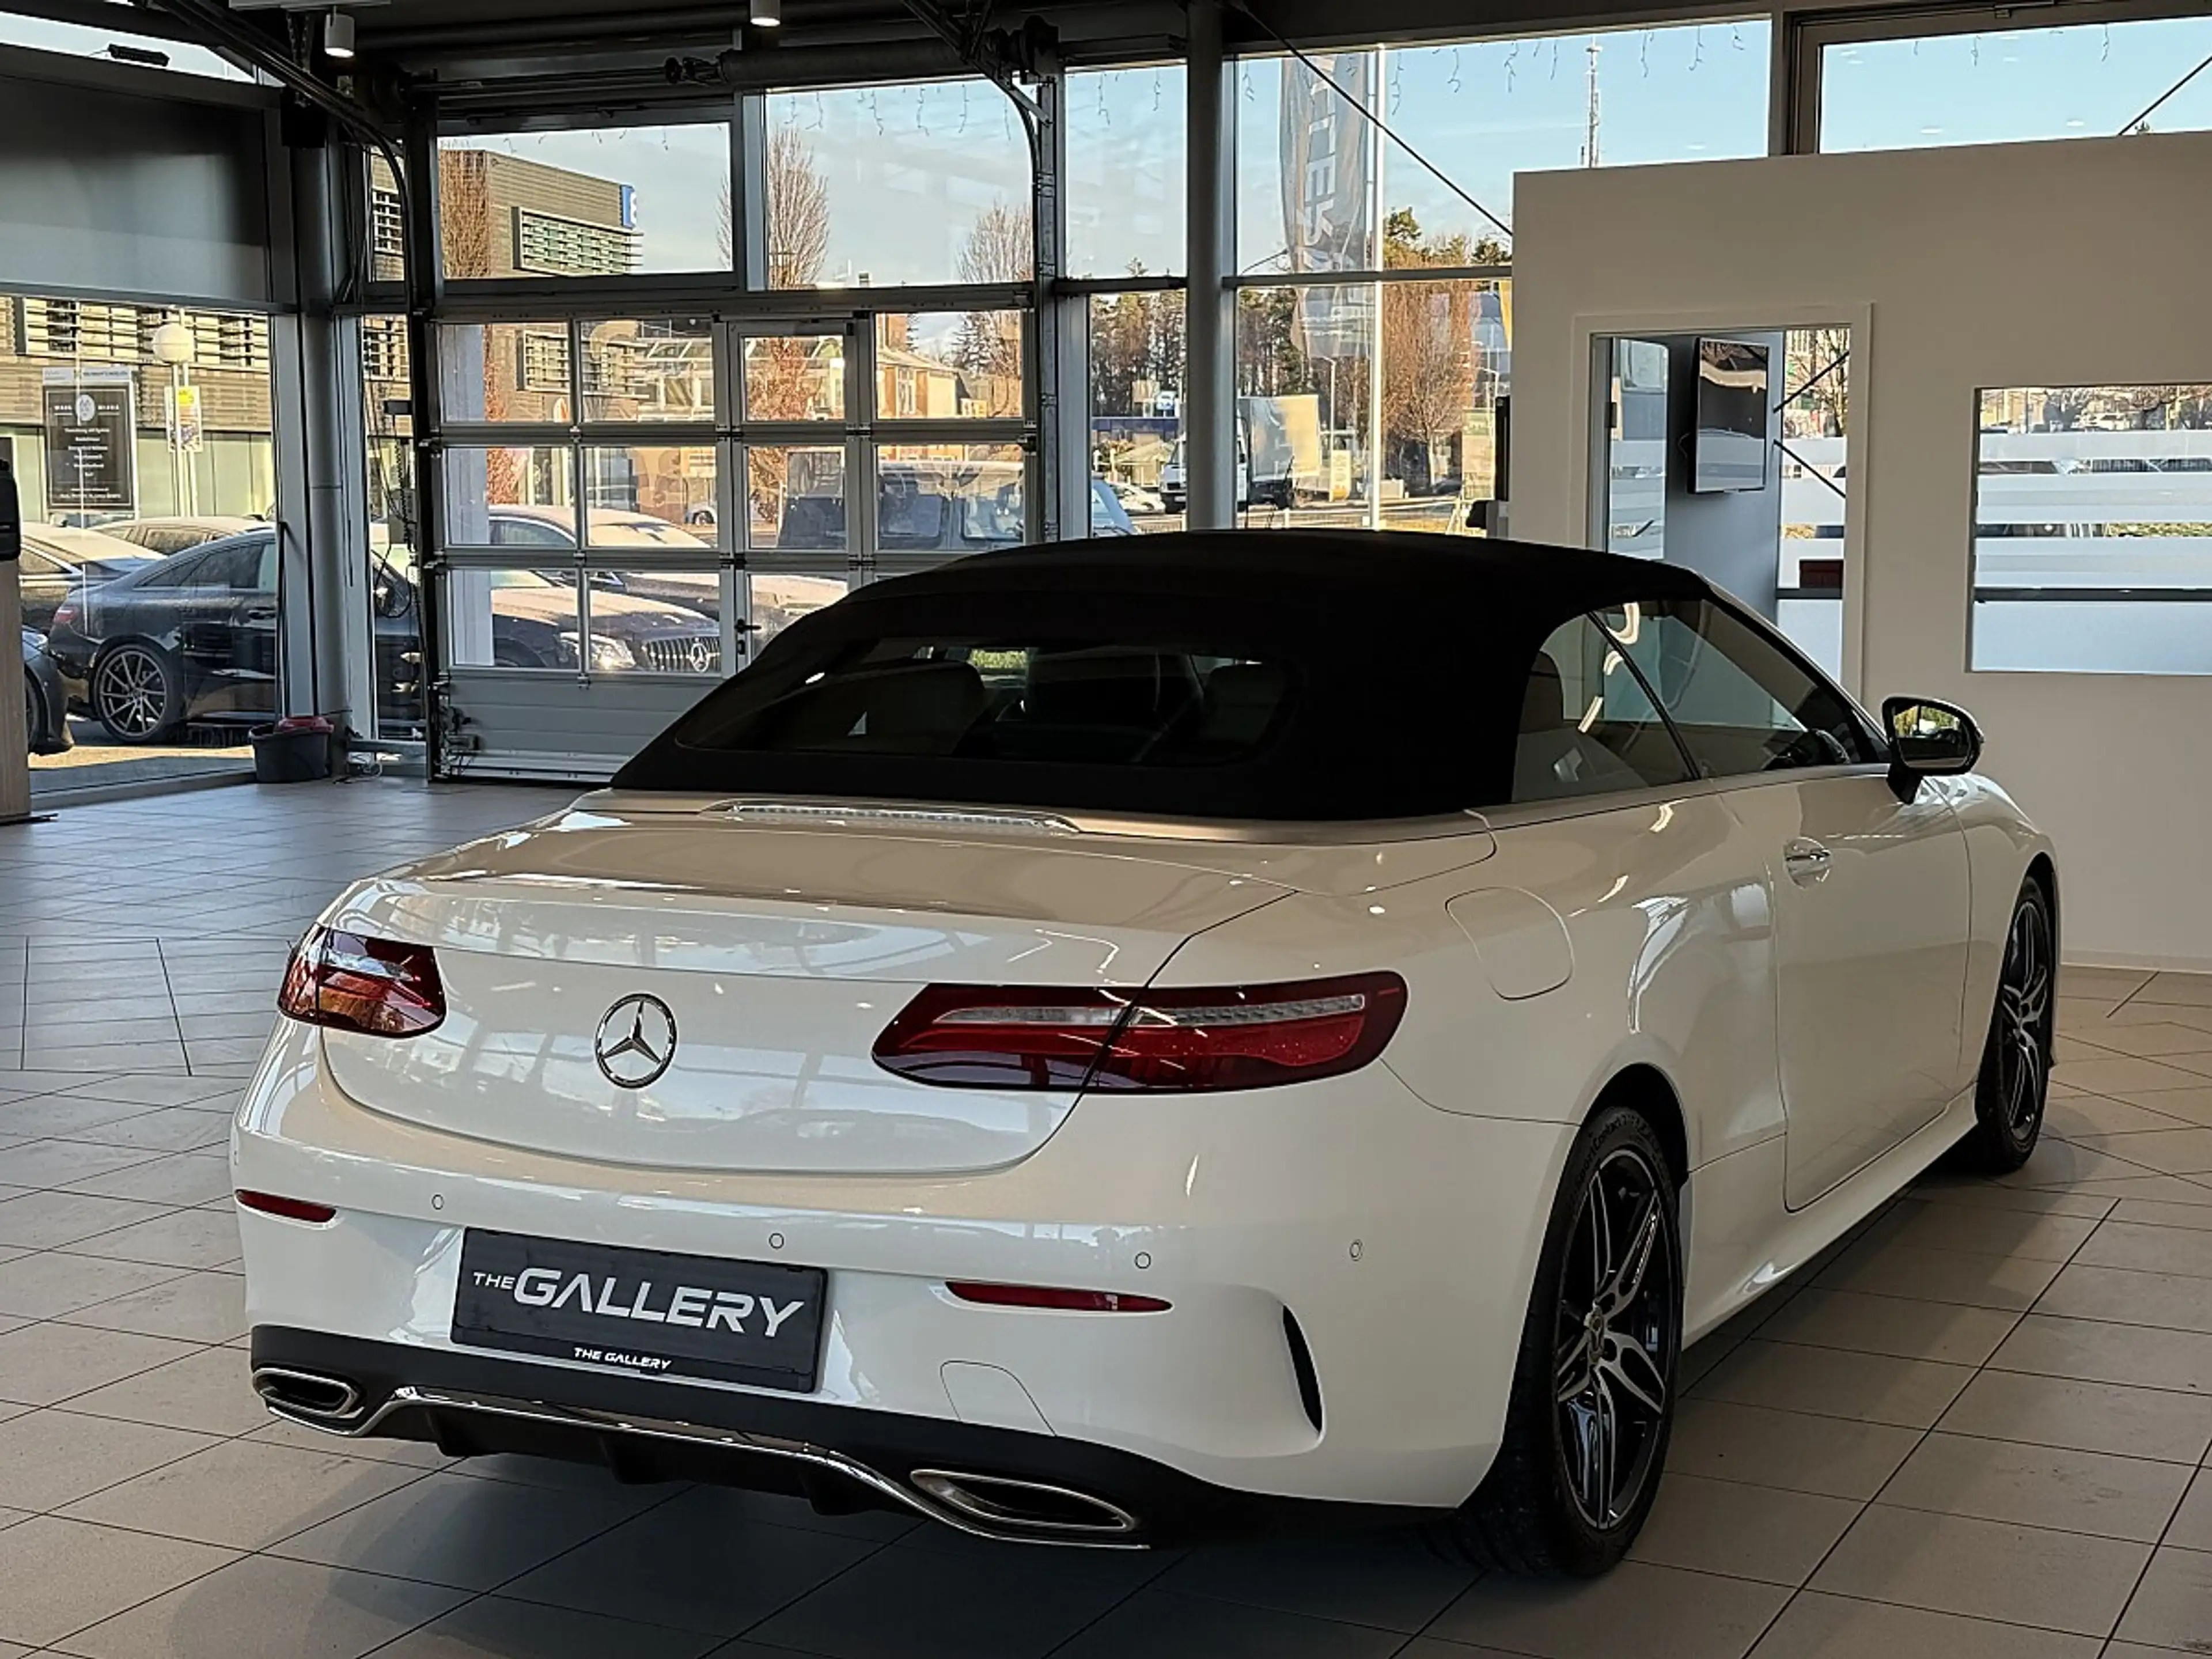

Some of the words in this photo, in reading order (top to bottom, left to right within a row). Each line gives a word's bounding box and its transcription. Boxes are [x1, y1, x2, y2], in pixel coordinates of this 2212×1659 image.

[473, 1271, 516, 1290] THE
[513, 1267, 804, 1338] GALLERY
[574, 1347, 602, 1361] THE
[604, 1352, 672, 1370] GALLERY
